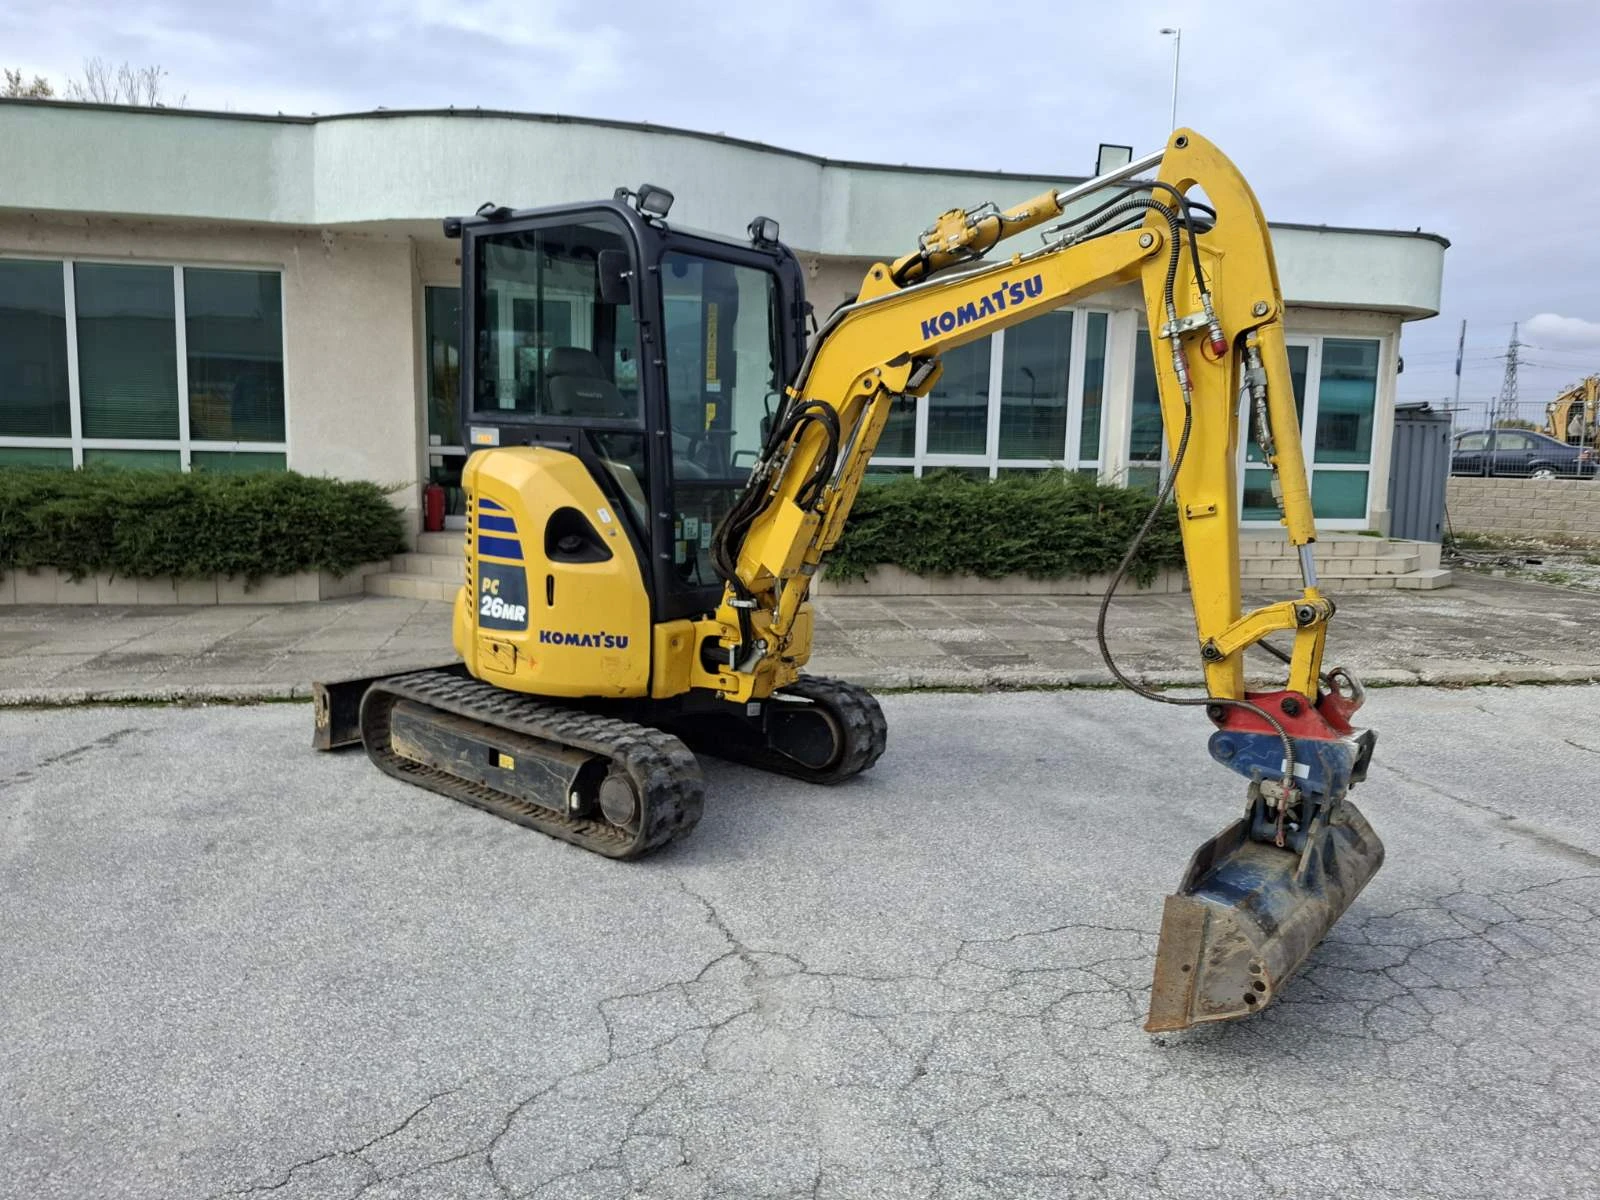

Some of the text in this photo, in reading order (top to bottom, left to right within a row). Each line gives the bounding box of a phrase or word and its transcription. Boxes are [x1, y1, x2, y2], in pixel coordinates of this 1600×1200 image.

[921, 274, 1043, 340] KOMATSU
[482, 577, 500, 595] PC
[480, 595, 526, 622] 26MR
[539, 630, 629, 649] KOMATSU
